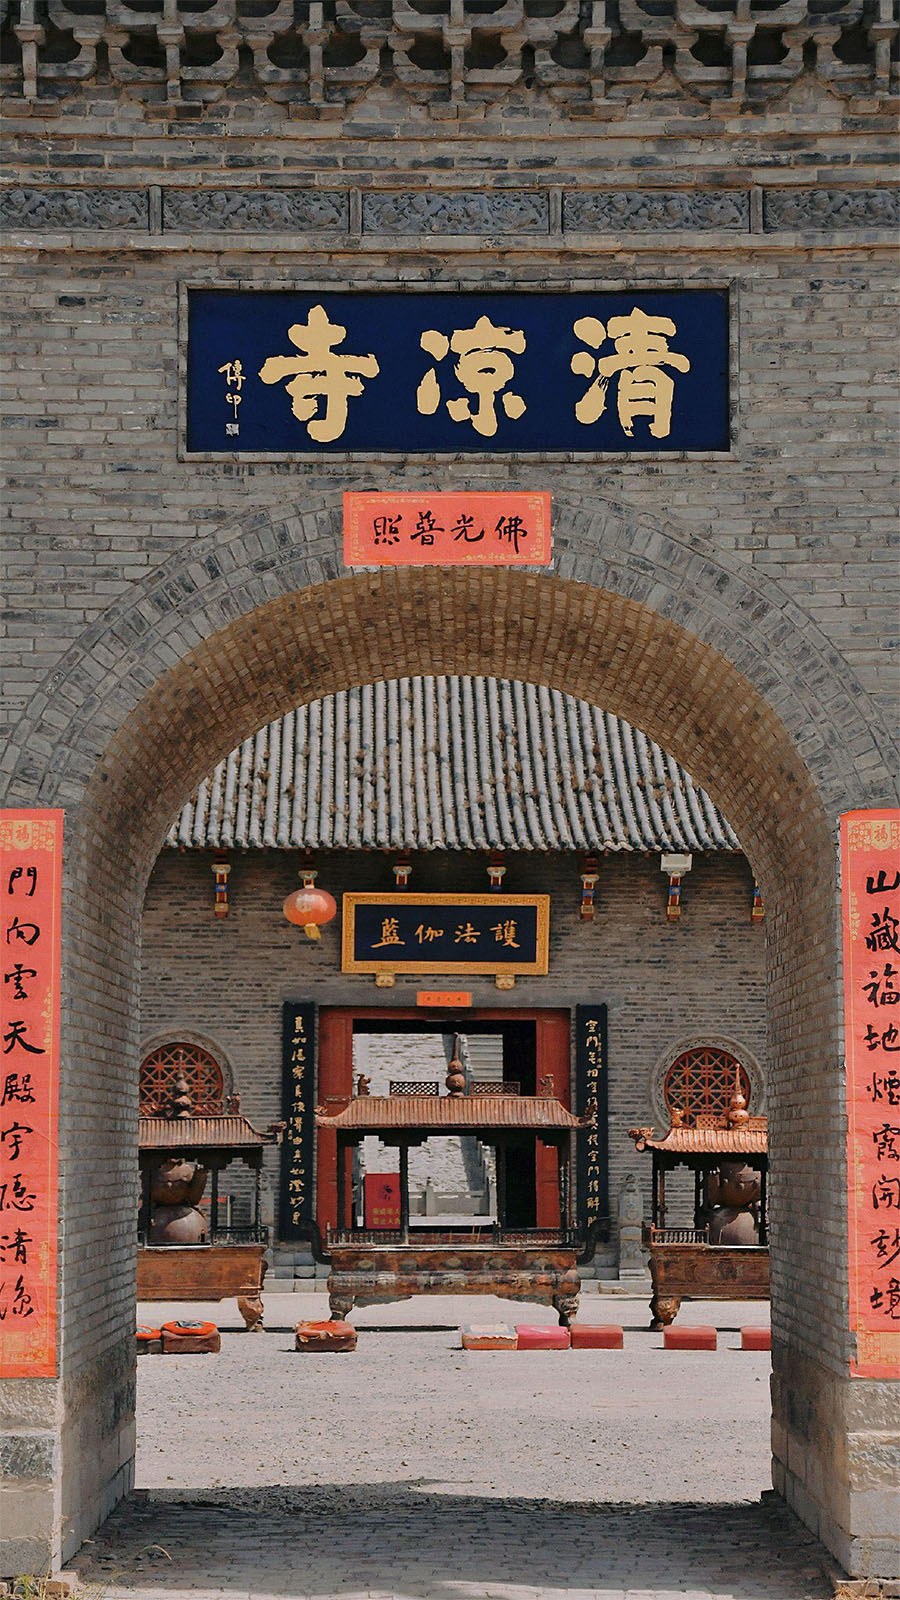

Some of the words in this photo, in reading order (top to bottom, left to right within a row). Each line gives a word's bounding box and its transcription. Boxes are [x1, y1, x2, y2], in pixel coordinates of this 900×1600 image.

[373, 510, 528, 554] 佛光普照
[15, 825, 30, 843] 福
[873, 823, 888, 843] 福
[371, 917, 521, 948] 護法伽藍
